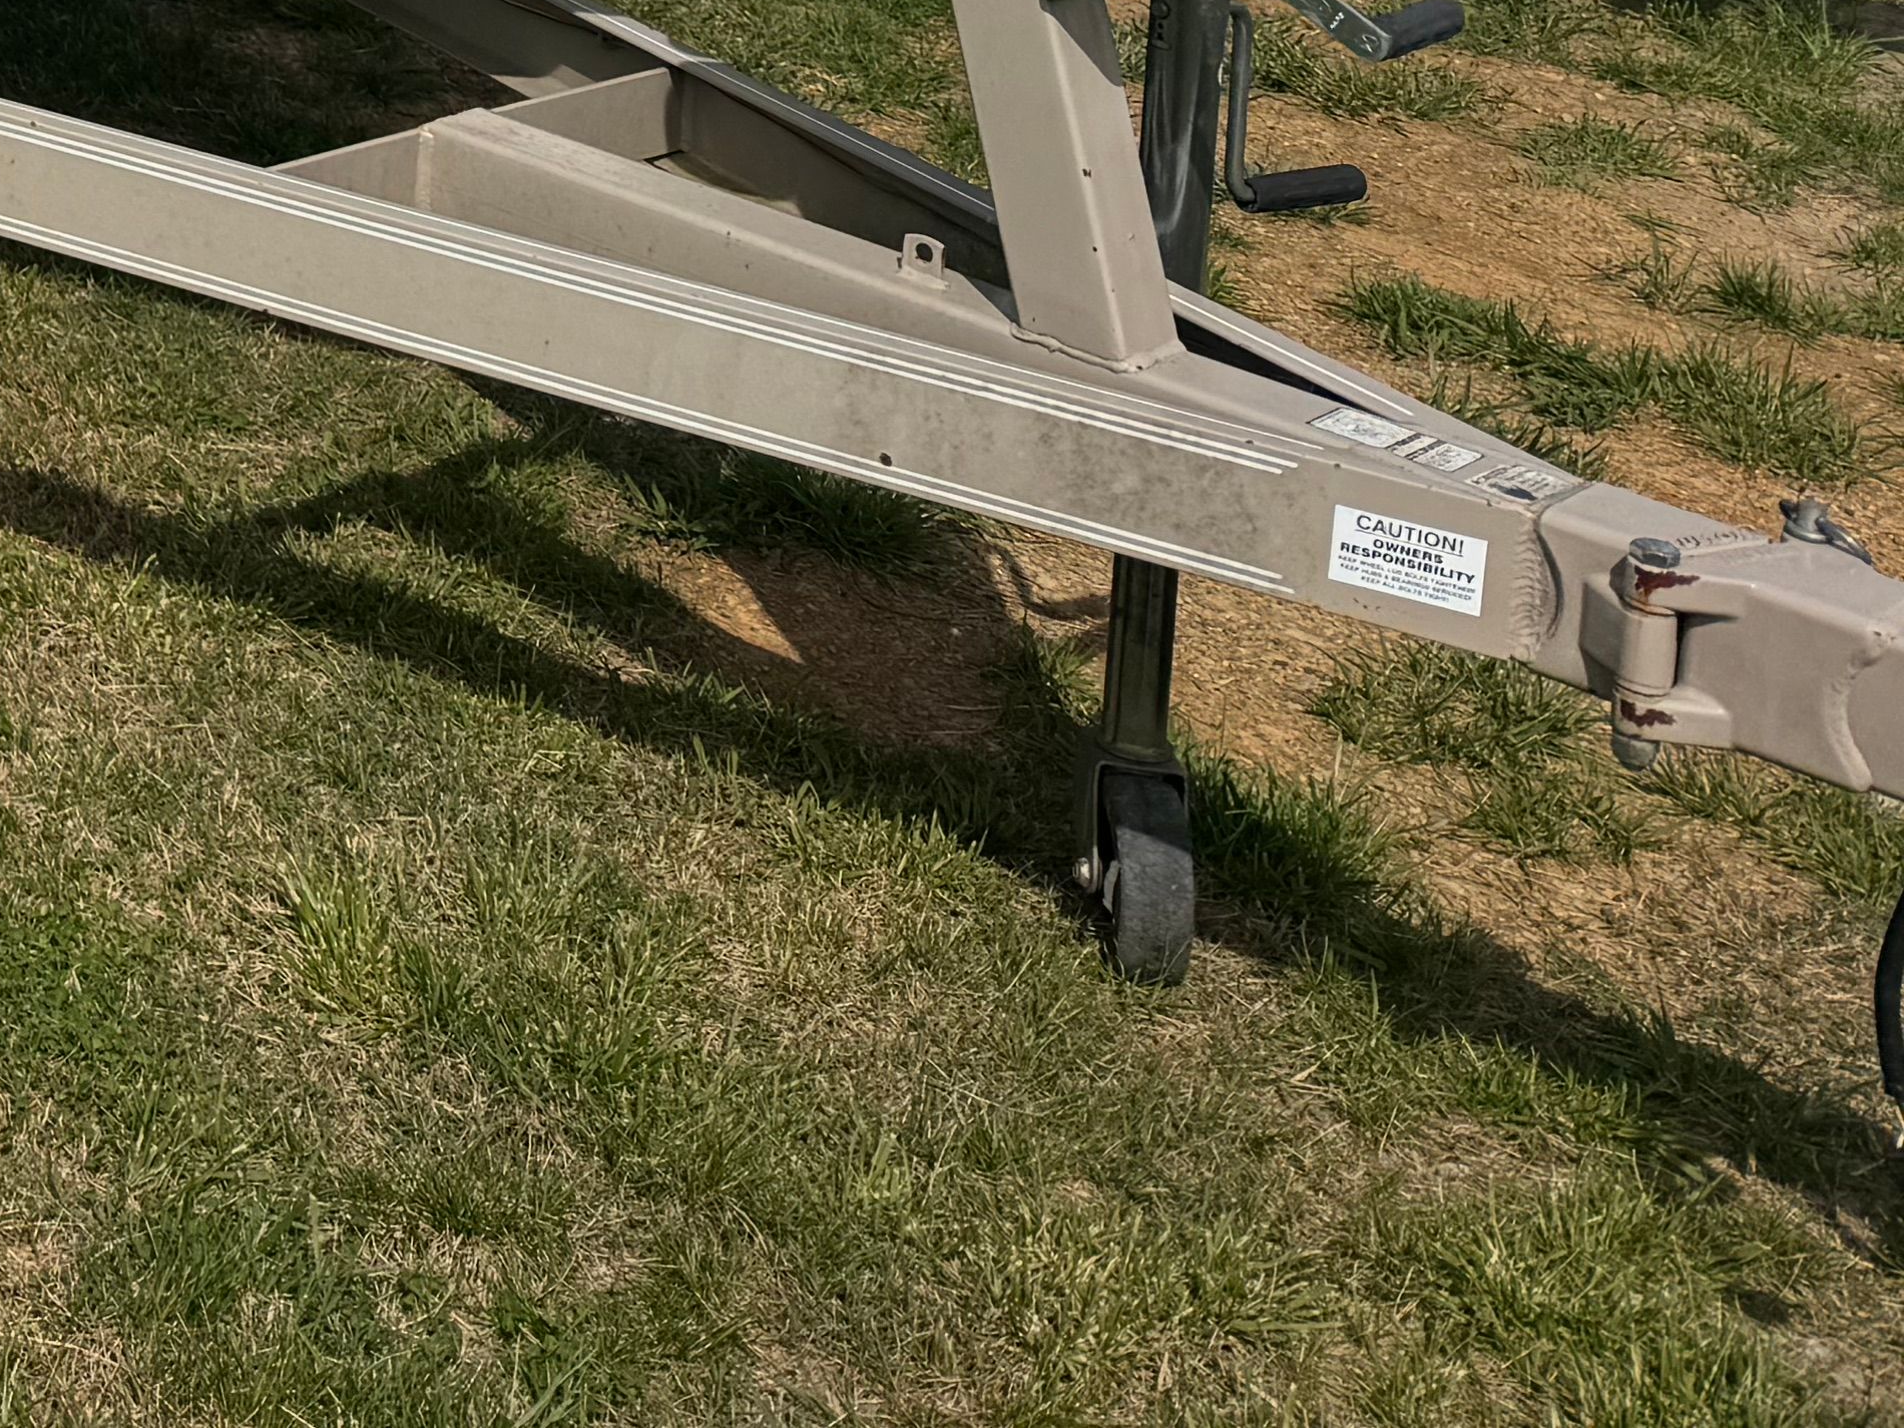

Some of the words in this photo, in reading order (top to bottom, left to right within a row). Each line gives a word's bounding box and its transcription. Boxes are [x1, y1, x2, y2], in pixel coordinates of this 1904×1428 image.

[1356, 514, 1465, 554] CAUTION!
[1373, 538, 1444, 564] OWNERS
[1340, 542, 1476, 584] RESPONSIBILITY
